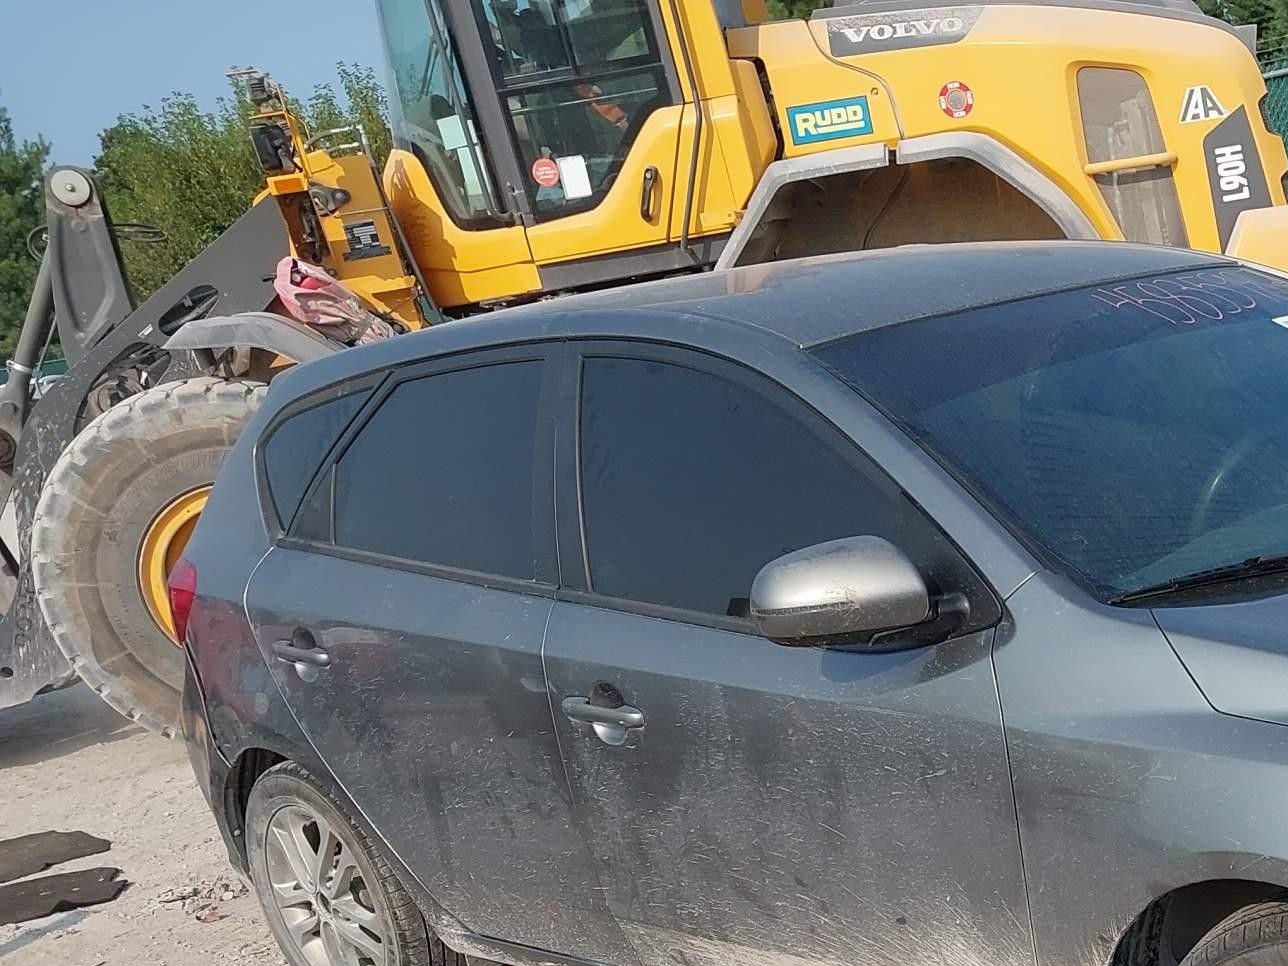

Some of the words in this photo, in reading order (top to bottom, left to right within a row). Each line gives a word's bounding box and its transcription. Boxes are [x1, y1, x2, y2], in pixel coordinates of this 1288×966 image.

[841, 17, 963, 43] VOLVO
[795, 105, 864, 136] RUDD
[1214, 144, 1251, 203] L90H
